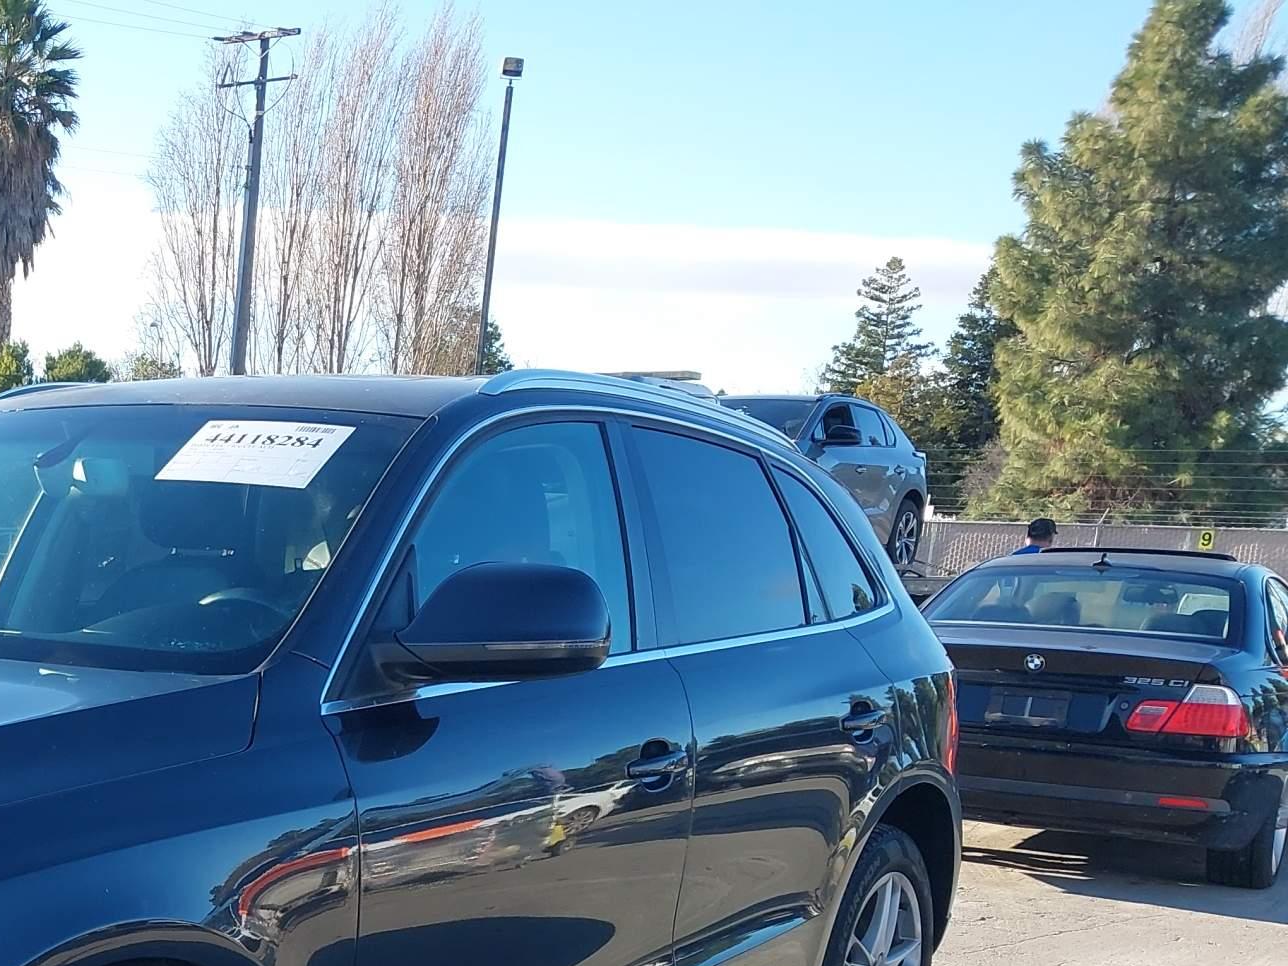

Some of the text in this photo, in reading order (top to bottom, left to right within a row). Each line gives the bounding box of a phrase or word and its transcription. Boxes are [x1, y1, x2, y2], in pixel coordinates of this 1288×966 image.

[205, 432, 324, 449] 44118284
[1201, 531, 1212, 547] 9
[1123, 676, 1165, 686] 325
